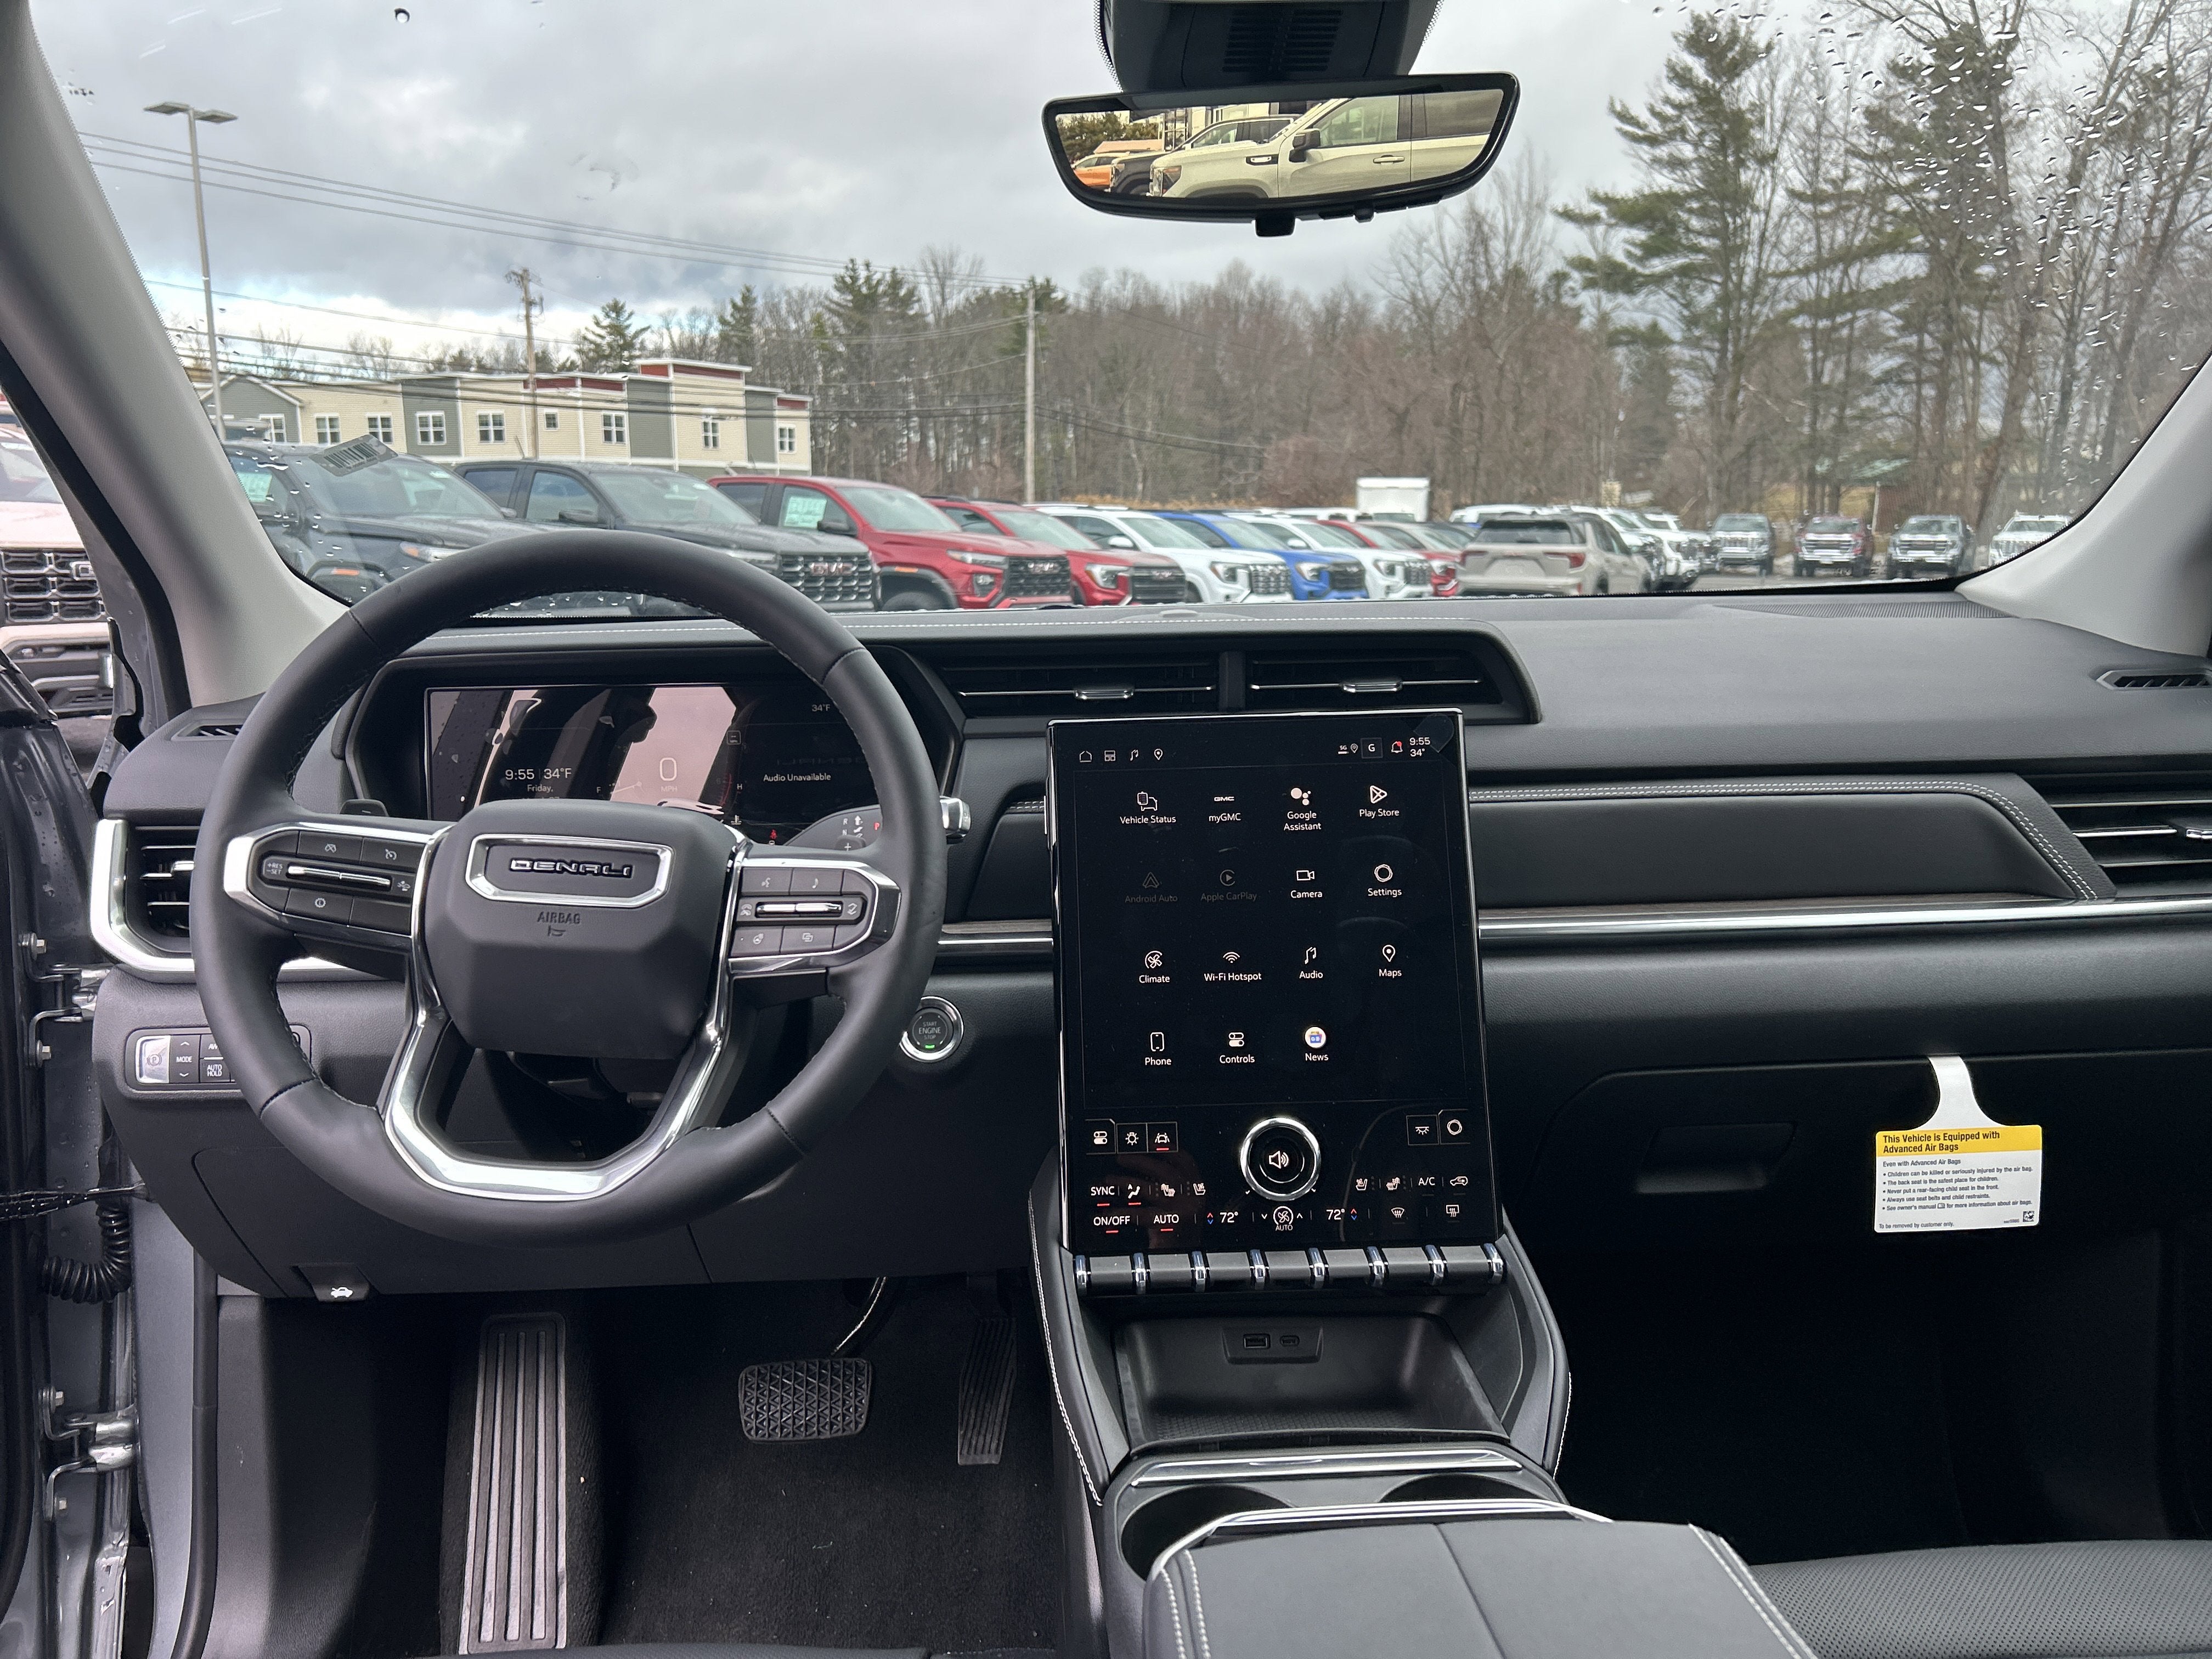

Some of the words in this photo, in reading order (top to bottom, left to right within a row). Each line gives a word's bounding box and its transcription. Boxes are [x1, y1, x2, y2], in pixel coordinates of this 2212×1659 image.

[1409, 737, 1431, 746] 9:55
[1410, 748, 1425, 757] 34°
[505, 769, 534, 780] 9:55
[544, 768, 572, 779] 34°F
[787, 773, 831, 781] Unavailable
[1209, 812, 1242, 823] myGMC
[1287, 810, 1317, 821] Google
[1359, 809, 1376, 819] Play
[1378, 808, 1400, 816] Store
[1120, 815, 1149, 824] Vehicle
[1150, 815, 1176, 823] Status
[1284, 822, 1322, 831] Assistant
[510, 858, 635, 878] DENALI
[1200, 893, 1224, 902] Apple
[1226, 891, 1257, 901] CarPlay
[1290, 890, 1323, 898] Camera
[1367, 888, 1402, 898] Settings
[1125, 894, 1157, 903] Android
[1159, 894, 1178, 902] Auto
[537, 911, 580, 924] AIRBAG
[1204, 973, 1227, 981] Wi-Fi
[1228, 972, 1262, 983] Hotspot
[1299, 970, 1323, 979] Audio
[1379, 968, 1402, 978] Maps
[1139, 974, 1170, 984] Climate
[1145, 1057, 1172, 1066] Phone
[1219, 1054, 1255, 1064] Controls
[1305, 1053, 1329, 1061] News
[1902, 1133, 1932, 1142] Vehicle
[1934, 1133, 1941, 1141] is
[1943, 1132, 1980, 1142] Equipped
[1982, 1131, 2000, 1139] with
[1883, 1144, 1923, 1153] Advanced
[1925, 1143, 1937, 1152] Air
[1939, 1143, 1959, 1152] Bags
[1418, 1177, 1435, 1186] A/C
[1091, 1186, 1115, 1196] SYNC
[1153, 1214, 1180, 1224] AUTO
[1220, 1211, 1239, 1223] 72°
[1326, 1209, 1345, 1220] 72°
[1093, 1216, 1131, 1226] ON/OFF
